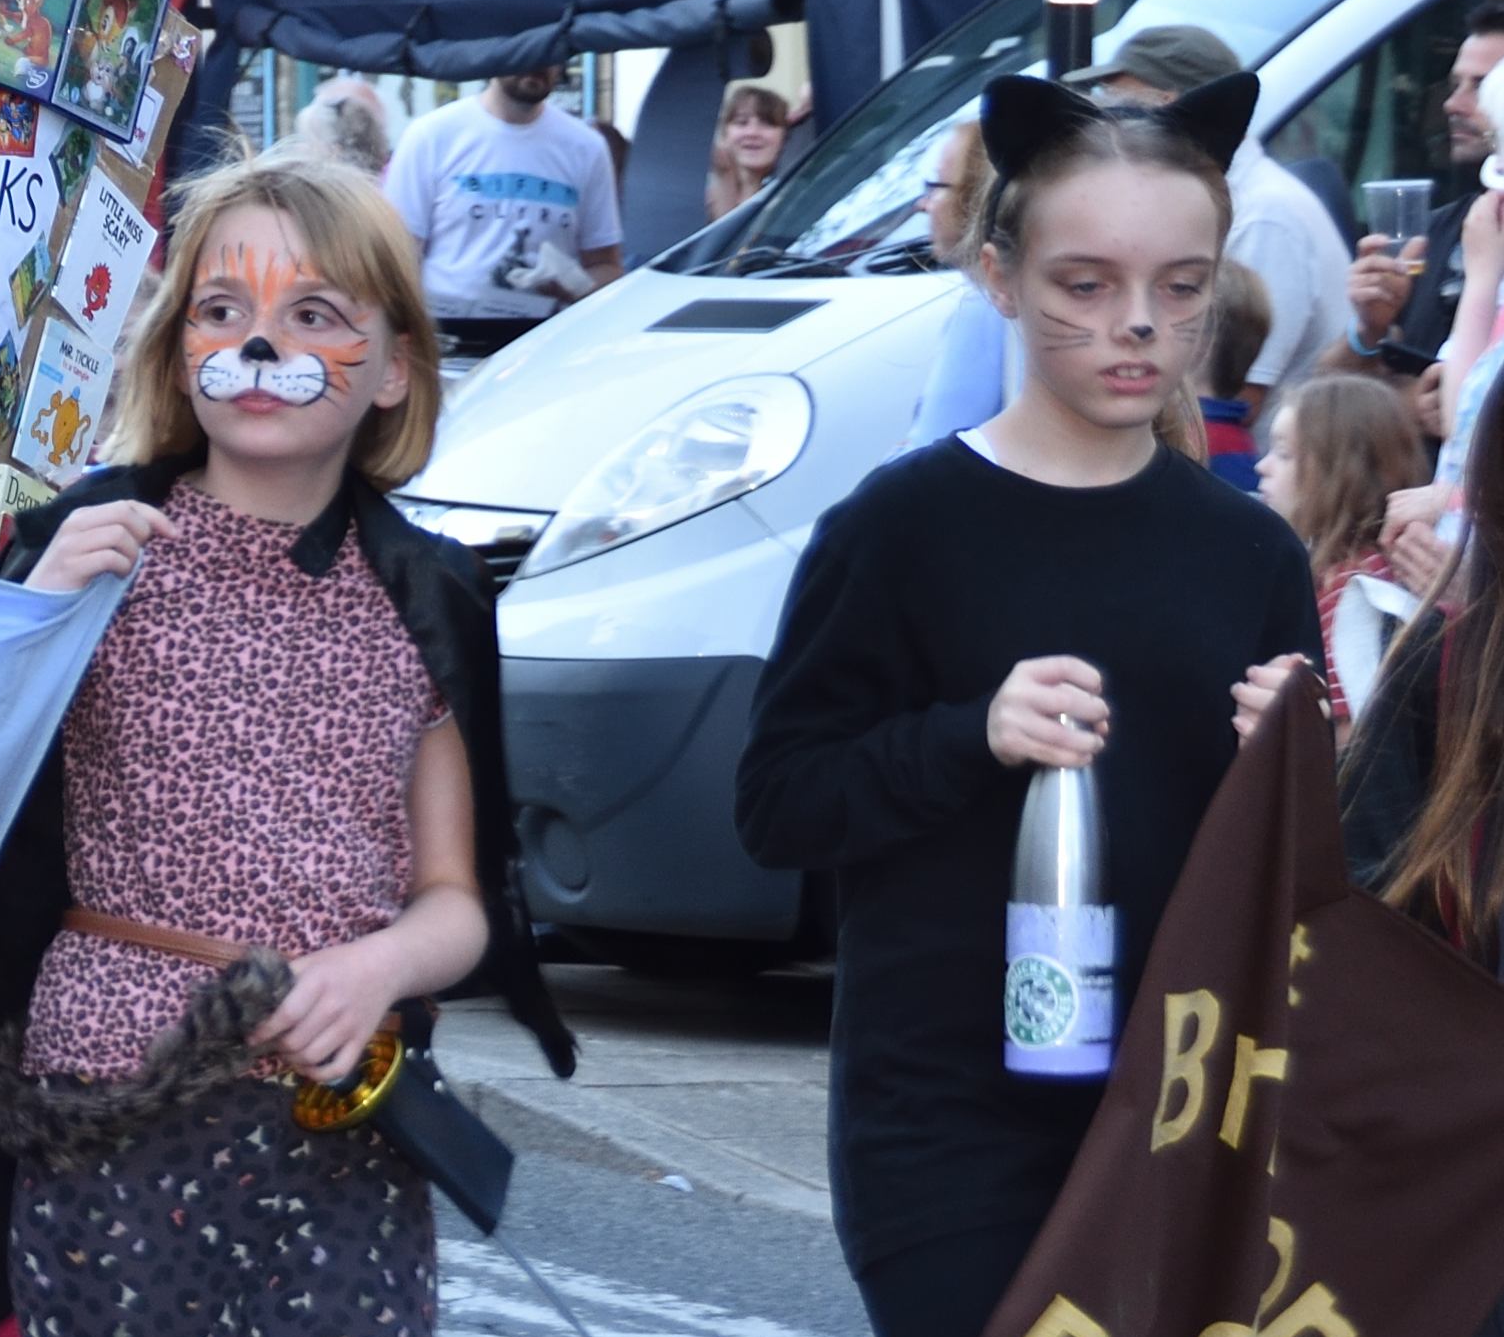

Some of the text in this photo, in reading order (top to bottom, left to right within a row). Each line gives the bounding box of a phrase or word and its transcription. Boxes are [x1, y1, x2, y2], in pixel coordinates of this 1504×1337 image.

[98, 186, 125, 220] LITTLE
[123, 213, 145, 246] MISS
[101, 213, 131, 252] SCARY
[75, 344, 101, 375] TICKLE
[5, 475, 42, 511] Dear
